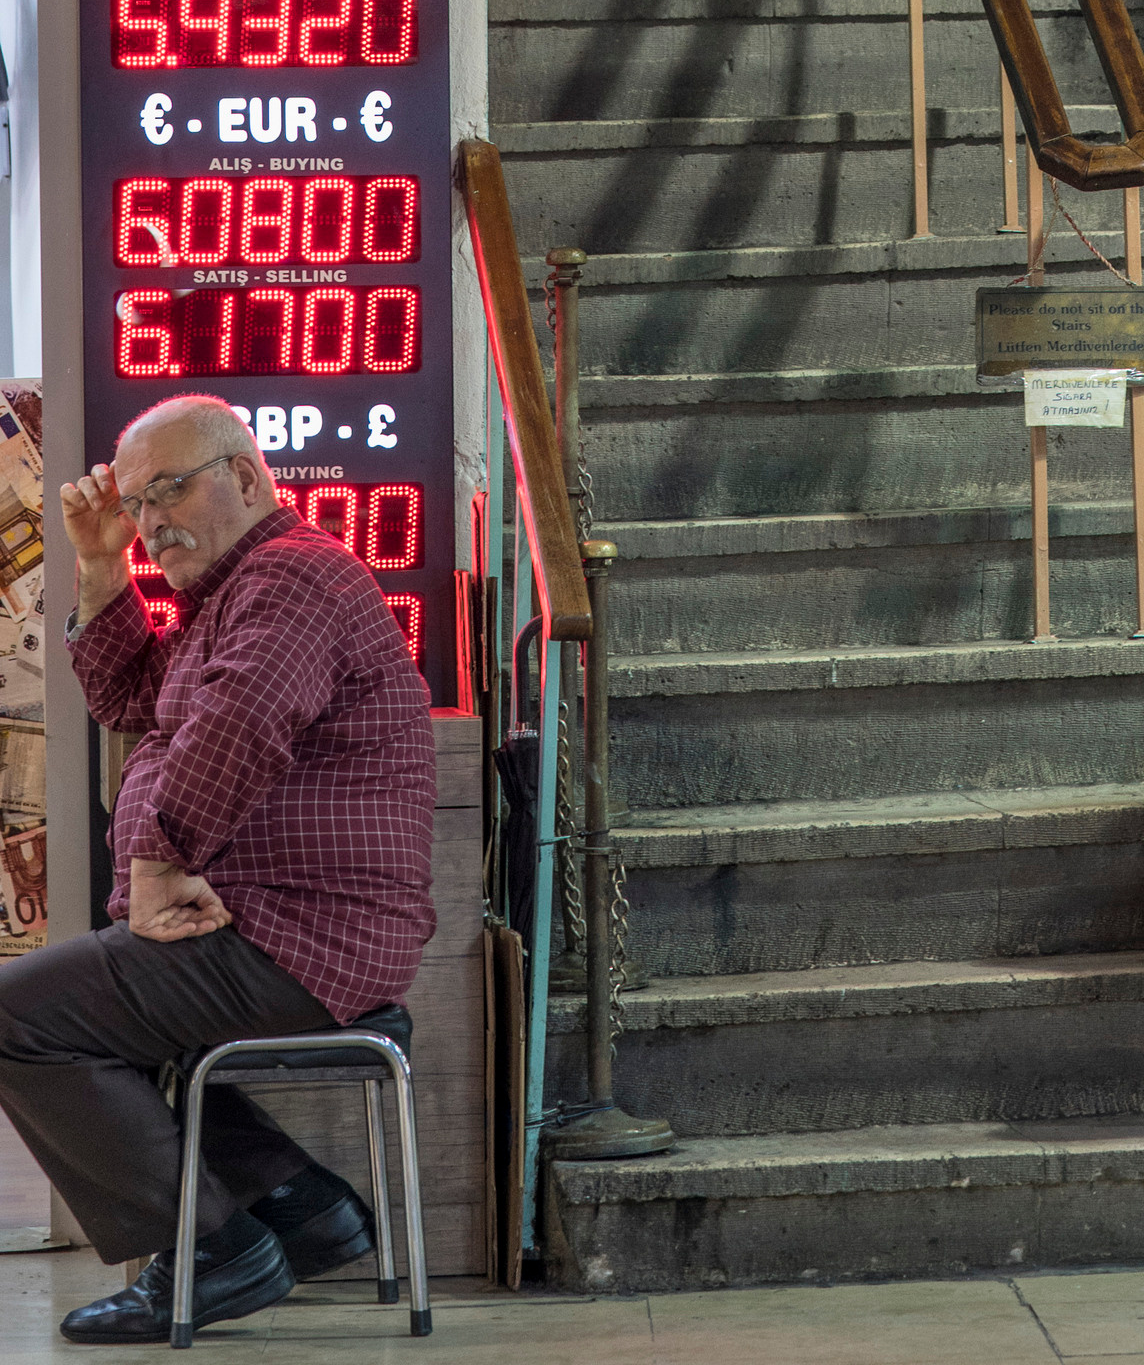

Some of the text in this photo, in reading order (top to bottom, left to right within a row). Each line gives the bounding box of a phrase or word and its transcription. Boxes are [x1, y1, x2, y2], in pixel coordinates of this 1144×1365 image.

[139, 89, 394, 146] € EUR €
[208, 157, 345, 174] ALIŞ BUYING
[117, 177, 417, 265] 6.0800
[193, 269, 348, 287] SATIŞ SELLING
[988, 303, 1034, 316] Please
[1038, 303, 1056, 315] do
[1060, 303, 1083, 315] not
[1087, 303, 1105, 315] sit
[1108, 304, 1126, 315] on
[119, 287, 418, 376] 6.1700
[1051, 319, 1092, 332] Stairs
[998, 339, 1144, 354] Lütfen Merdivenlerde
[366, 403, 399, 450] £
